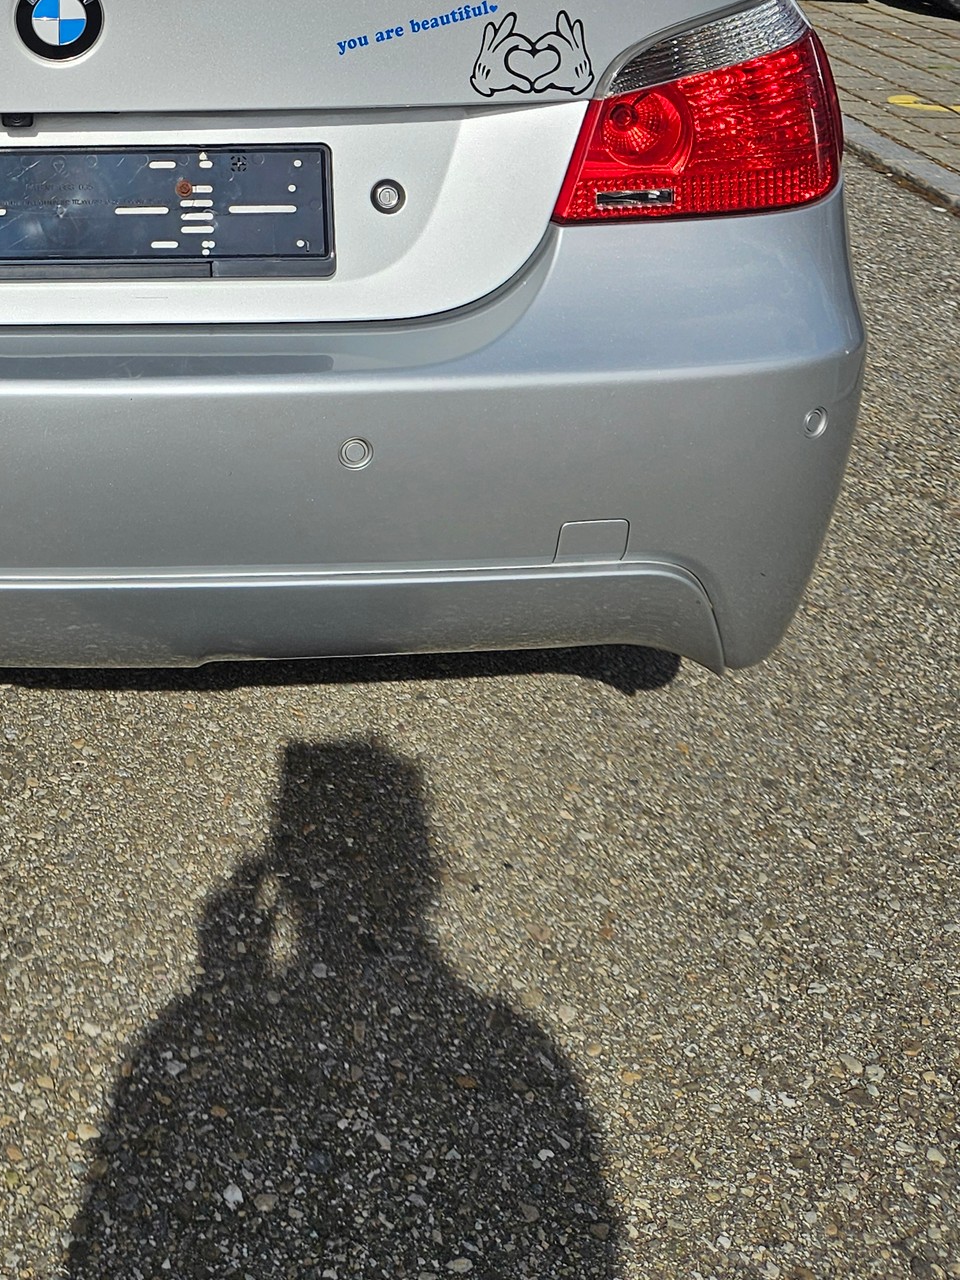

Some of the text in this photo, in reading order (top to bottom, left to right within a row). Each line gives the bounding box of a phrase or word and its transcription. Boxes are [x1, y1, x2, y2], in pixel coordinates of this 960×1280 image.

[337, 0, 491, 55] you are beautiful
